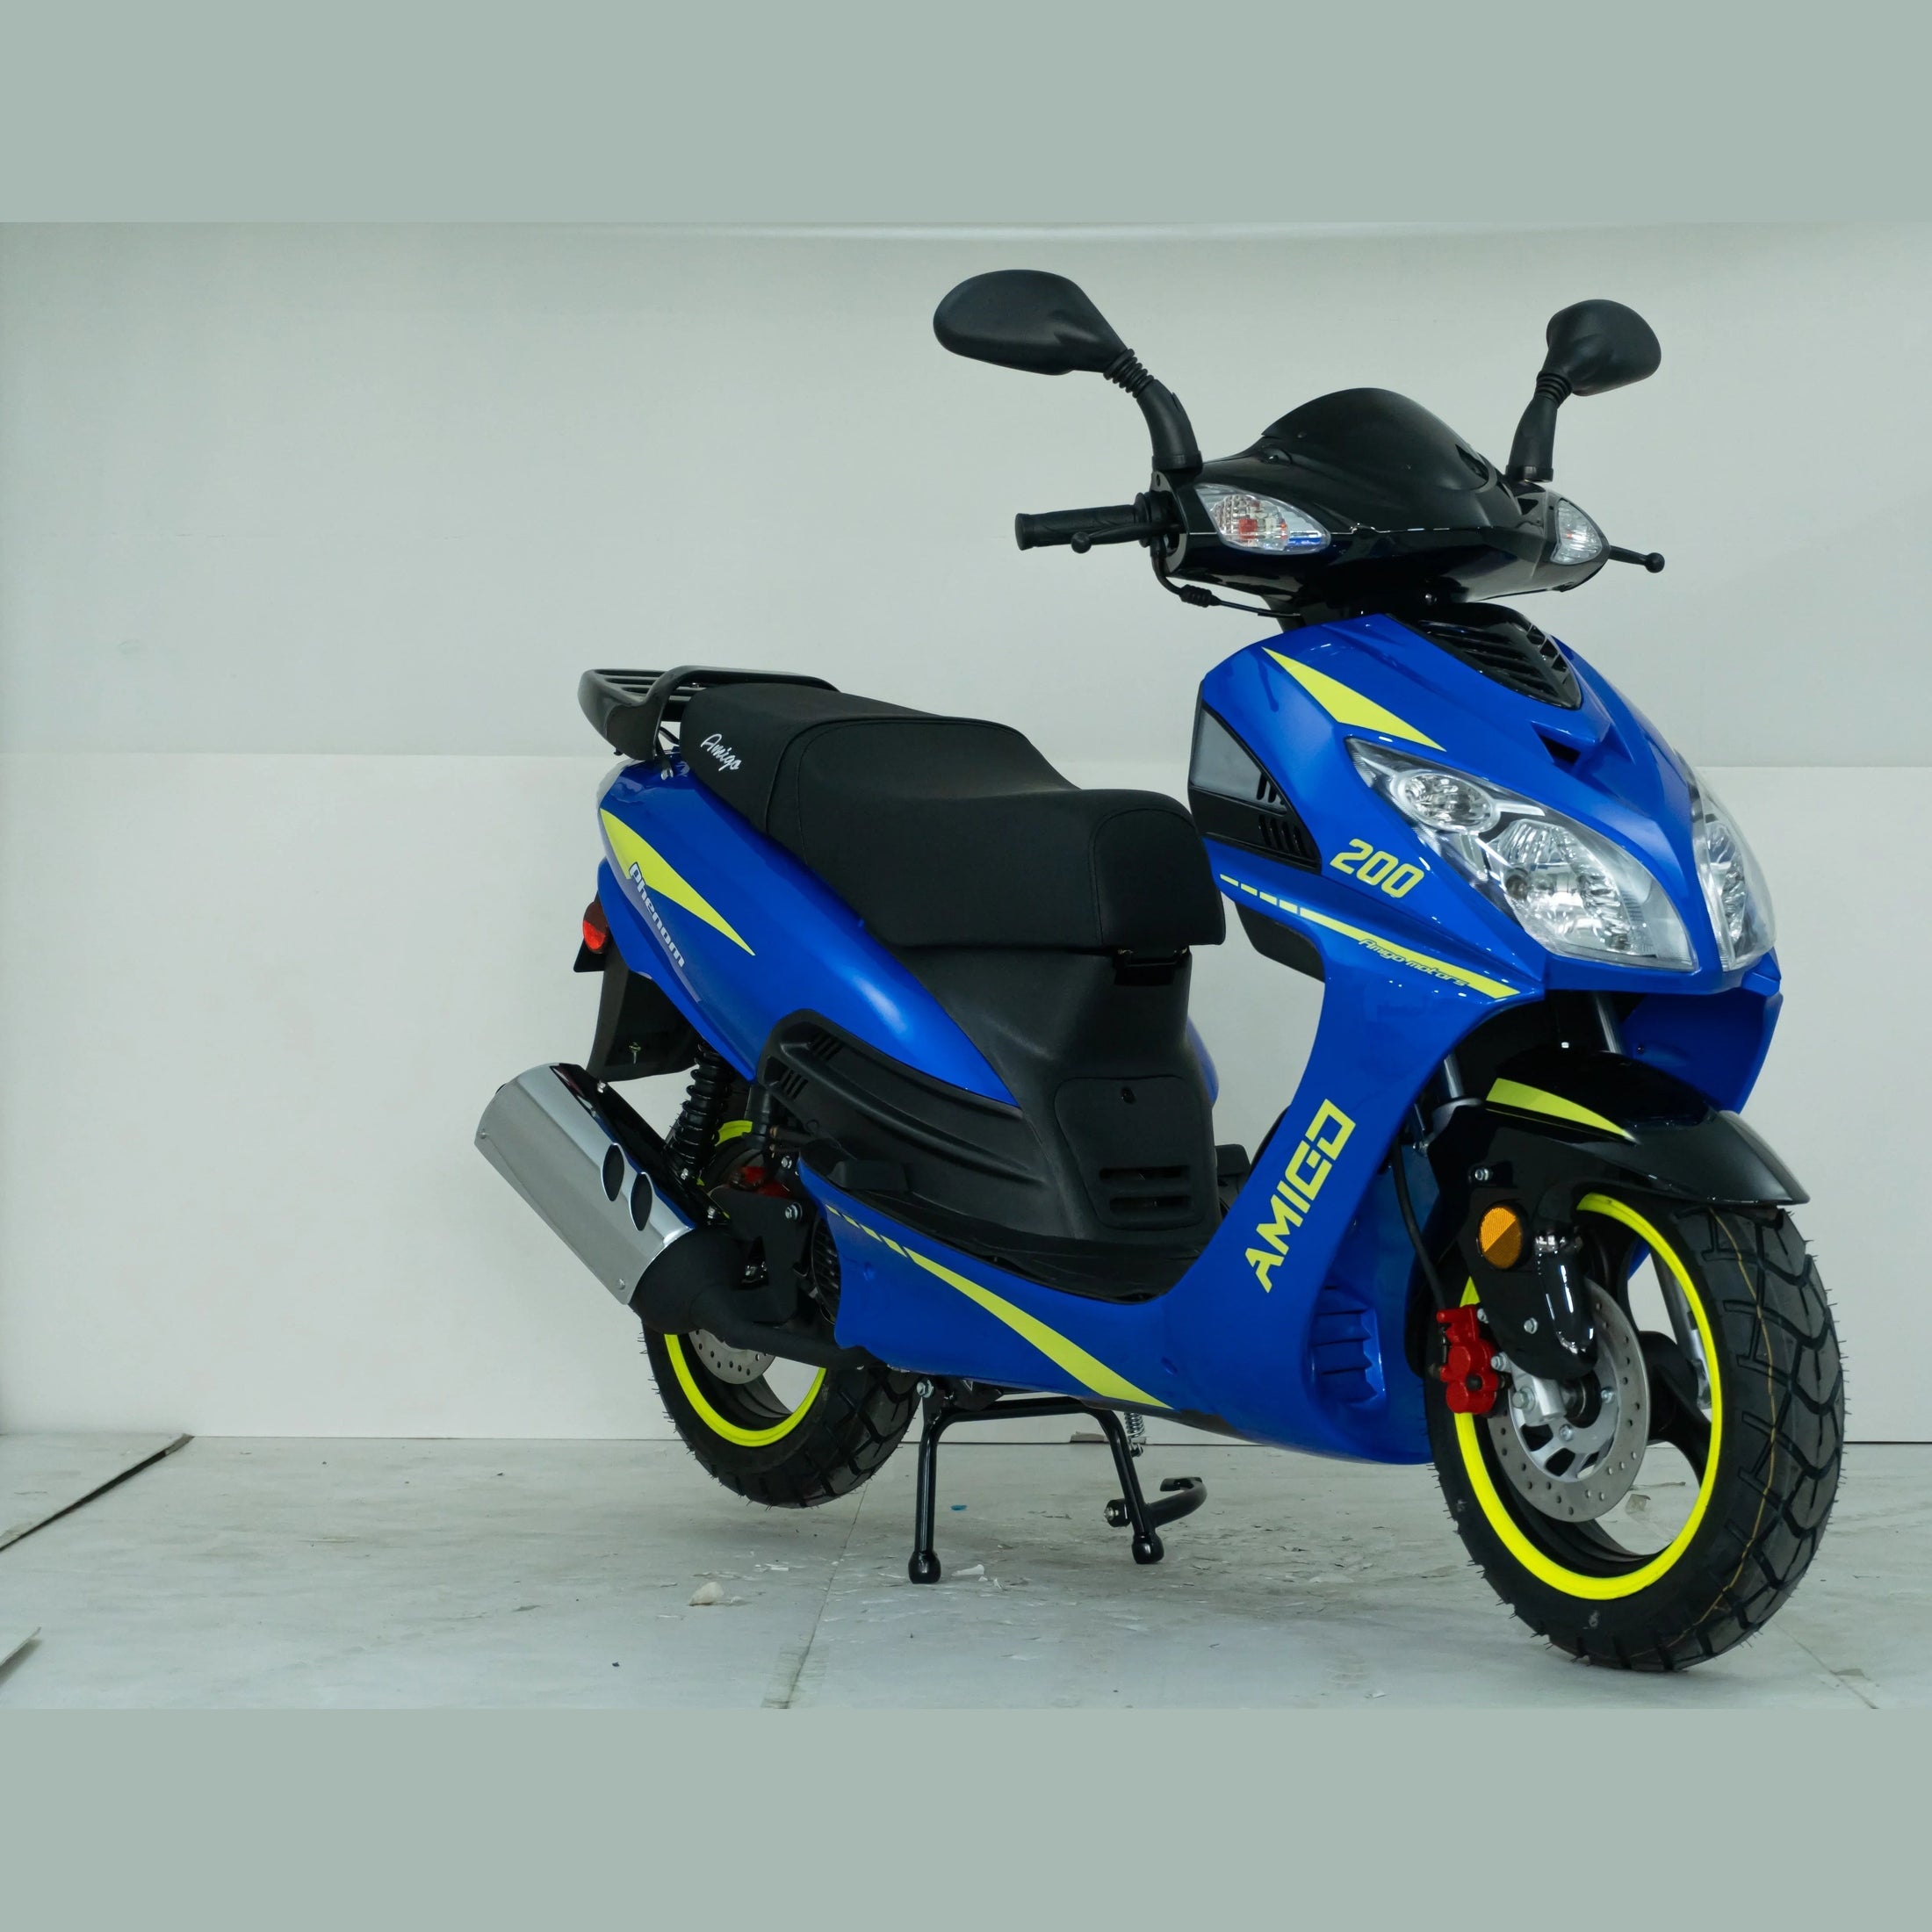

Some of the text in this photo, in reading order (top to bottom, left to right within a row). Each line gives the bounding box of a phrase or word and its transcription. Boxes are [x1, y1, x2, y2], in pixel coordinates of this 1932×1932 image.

[701, 733, 742, 771] Amigo
[1330, 839, 1424, 898] 200
[629, 862, 685, 967] Phenom
[1245, 1099, 1356, 1293] AMIGO
